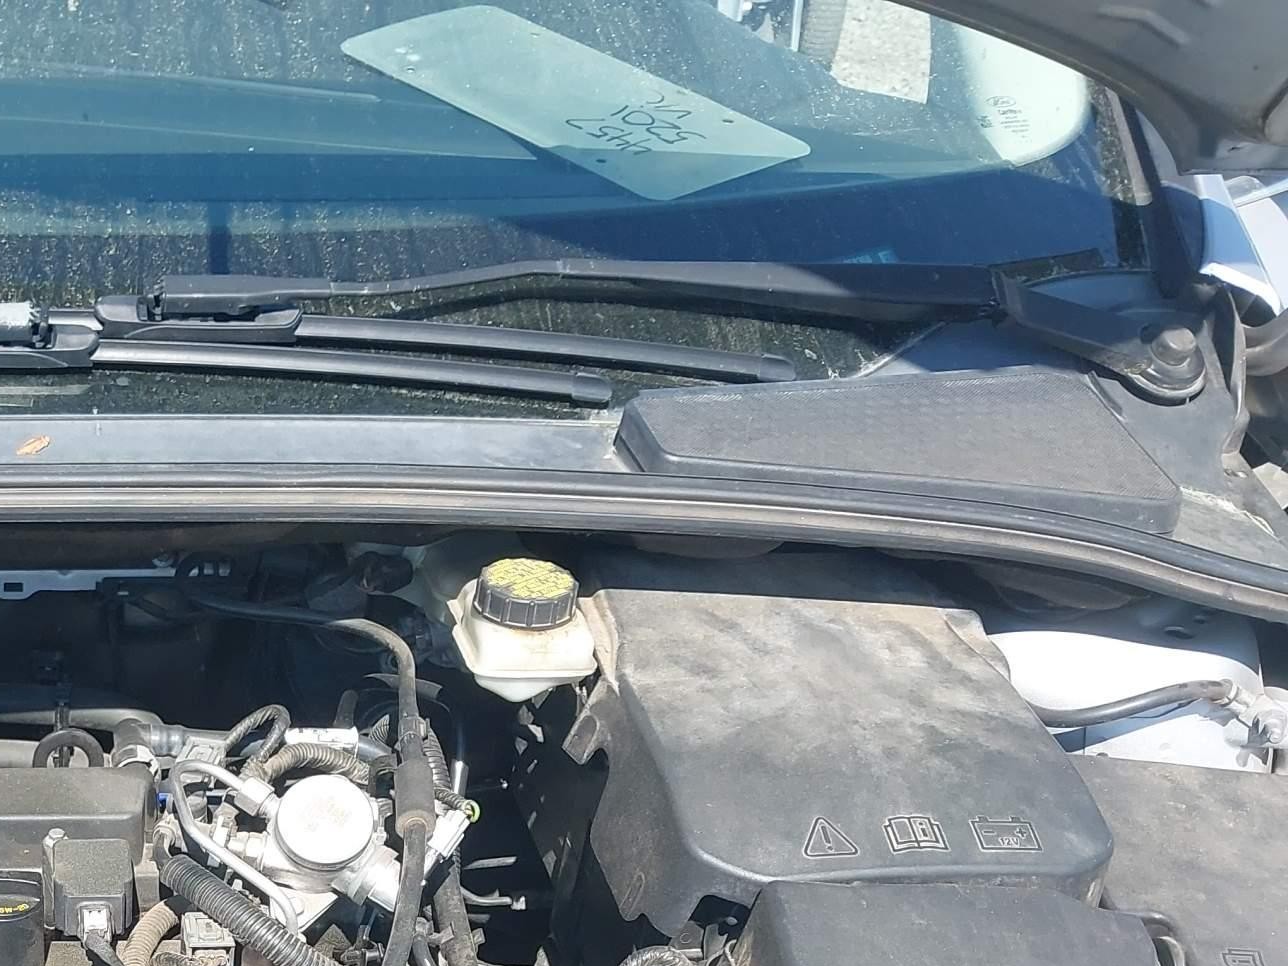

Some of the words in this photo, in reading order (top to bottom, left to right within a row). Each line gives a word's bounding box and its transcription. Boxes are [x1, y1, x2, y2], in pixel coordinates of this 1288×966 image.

[564, 118, 653, 155] 4457
[610, 105, 707, 144] 5201
[998, 836, 1020, 848] 12V
